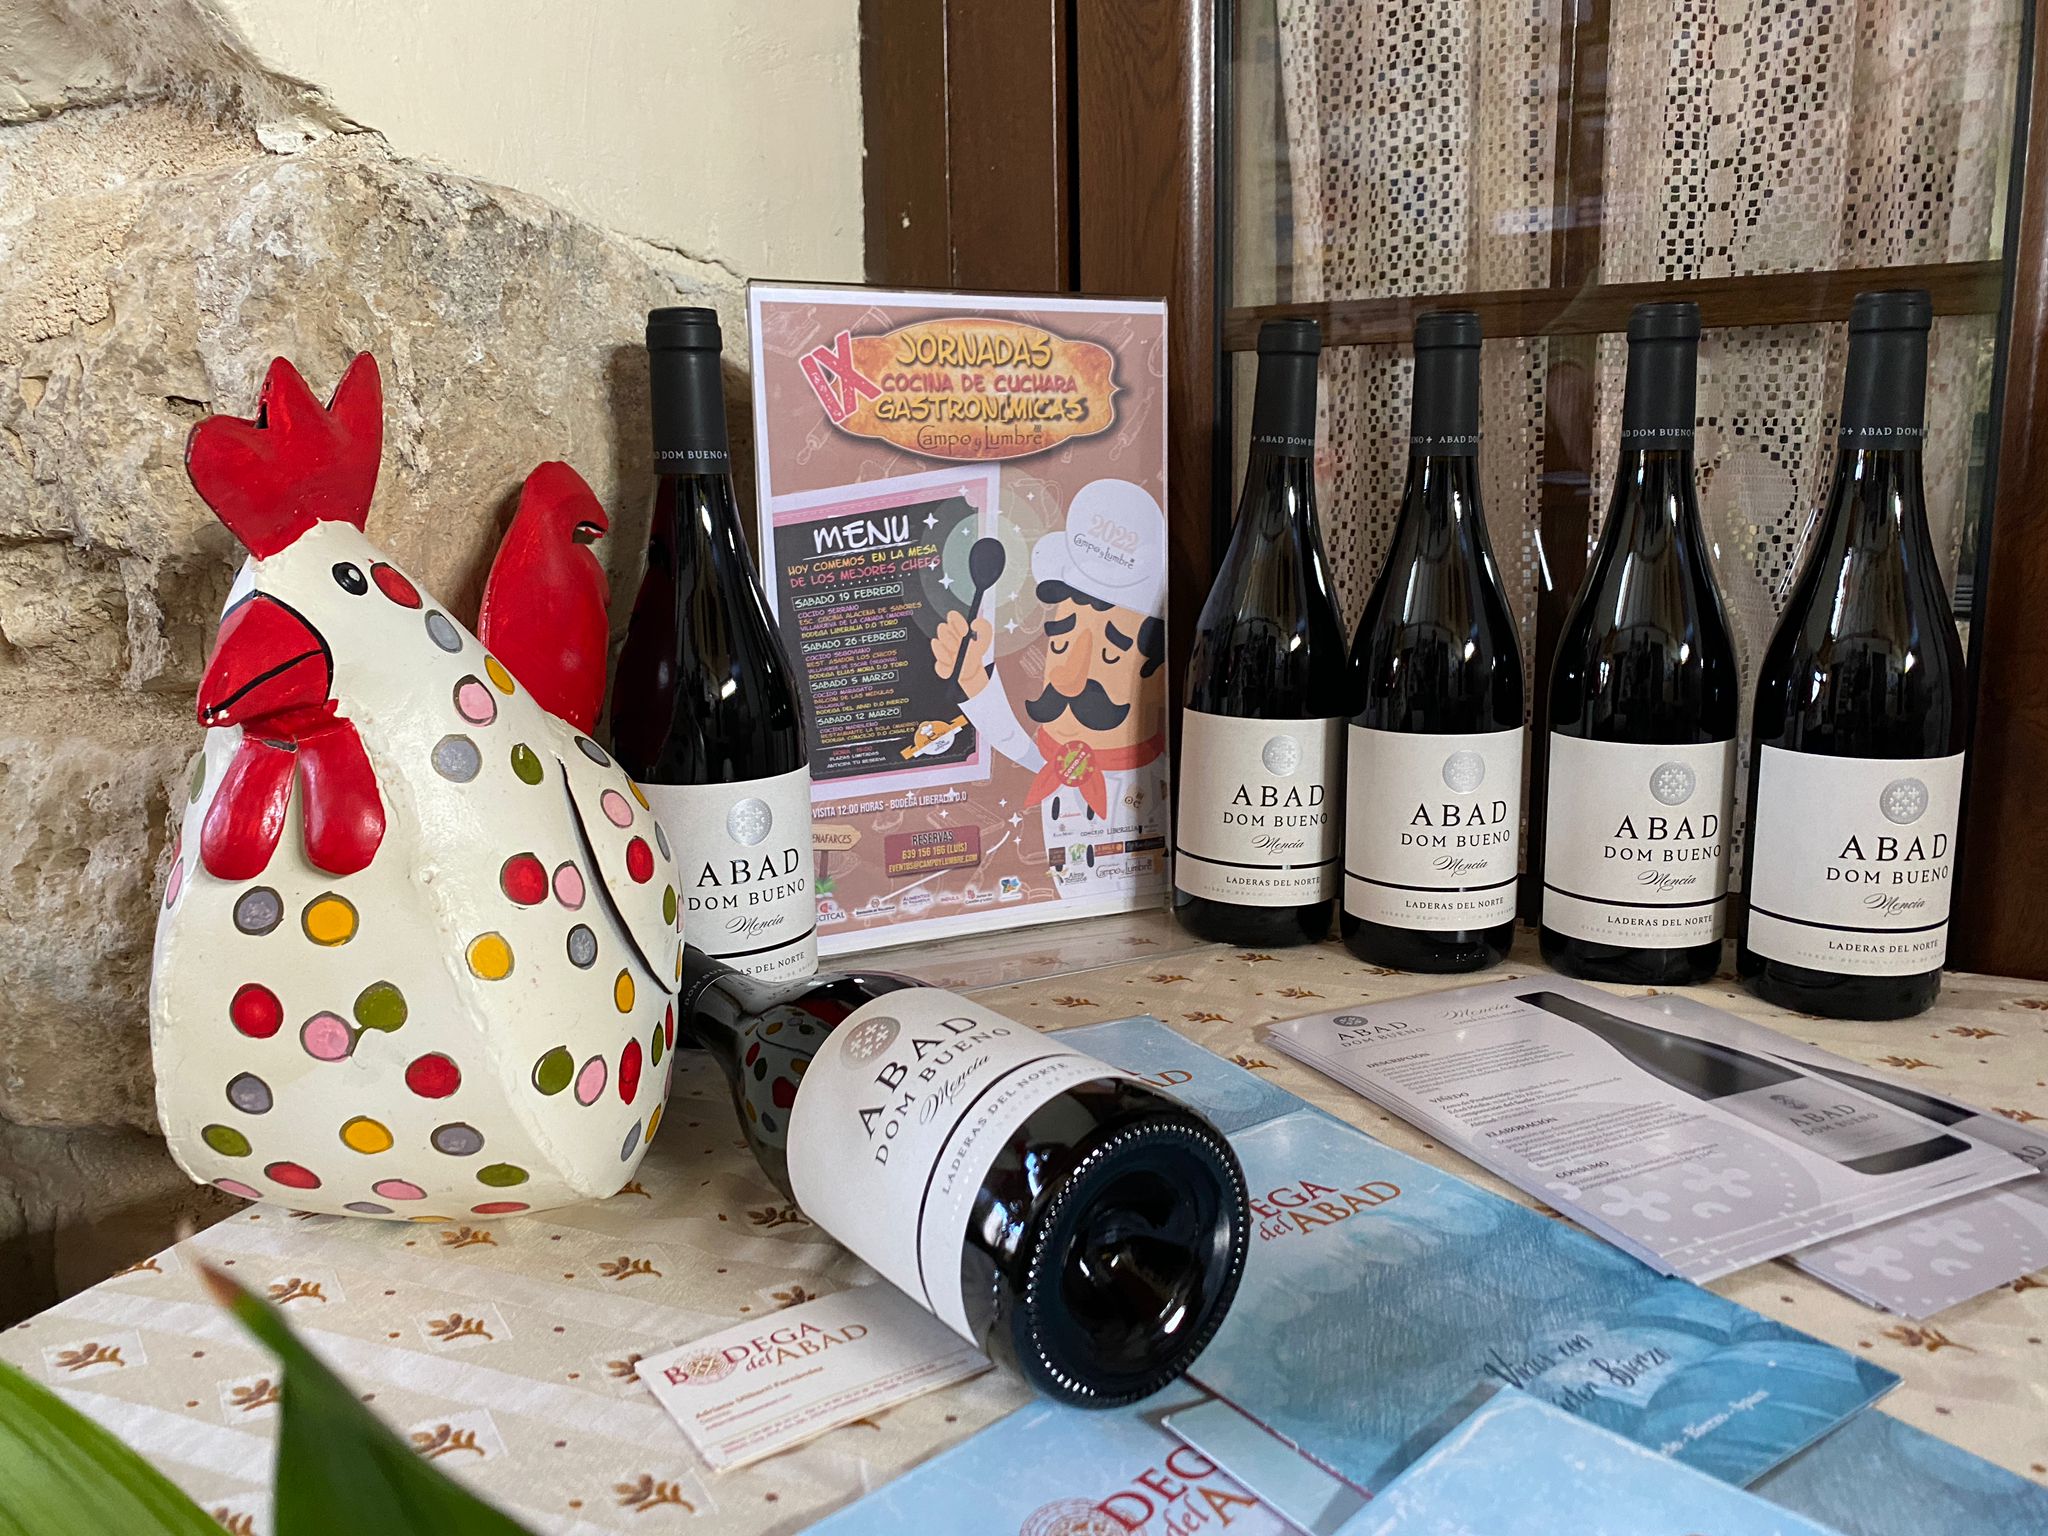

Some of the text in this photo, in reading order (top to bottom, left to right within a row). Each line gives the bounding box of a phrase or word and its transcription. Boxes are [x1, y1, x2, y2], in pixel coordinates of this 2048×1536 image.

[896, 333, 1053, 368] JORNADAS
[799, 330, 882, 424] IX
[881, 373, 1078, 393] COCINA DE CUCHARA
[917, 424, 1042, 454] Campo y Lumbre
[1260, 435, 1307, 446] ABAD DOM
[1439, 436, 1466, 444] ABAD
[1633, 429, 1656, 437] DOM
[1660, 429, 1691, 437] BUENO
[1860, 427, 1918, 436] ABAD DOM
[661, 450, 722, 459] DOM BUENO
[813, 515, 909, 554] MENU
[1088, 514, 1138, 554] 2022
[788, 544, 938, 575] HOY COMEMOS EN LA MESA
[1074, 533, 1101, 553] Campo
[1104, 546, 1135, 570] Lumbre
[790, 555, 941, 588] DE LOS MEJORES CHEFS
[795, 584, 901, 608] SABADO 19 FEBRERO
[802, 630, 906, 653] SABADO 26 FEBRERO
[811, 672, 895, 690] SABADO 5 MARZO
[816, 715, 852, 726] SABADO
[868, 708, 900, 718] MARZO
[1232, 784, 1325, 807] ABAD
[812, 807, 835, 818] VISITA
[838, 804, 859, 815] 12:00
[860, 801, 884, 812] HORAS
[891, 797, 917, 808] BODEGA
[1410, 800, 1507, 827] ABAD
[1223, 812, 1328, 827] DOM BUENO
[1614, 814, 1718, 840] ABAD
[813, 833, 852, 844] ENAFARCES
[912, 831, 953, 845] RESERVAS
[1401, 830, 1510, 848] DOM BUENO
[1838, 833, 1948, 862] ABAD
[1604, 845, 1721, 862] DOM BUENO
[696, 848, 800, 888] ABAD
[1826, 865, 1949, 885] DOM BUENO
[1226, 876, 1321, 887] LADERAS DEL NORTE
[688, 878, 805, 911] DOM BUENO
[1405, 897, 1504, 910] LADERAS DEL NORTE
[1607, 915, 1713, 927] LADERAS DEL NORTE
[1828, 939, 1939, 953] LADERAS DEL NORTE
[755, 963, 775, 974] DEL
[778, 951, 805, 968] NORTE
[1337, 1021, 1409, 1042] ABAD
[1340, 1026, 1427, 1048] DOM BUENO
[858, 1016, 978, 1140] ABAD
[875, 1027, 1013, 1167] DOM BUENO
[1789, 1104, 1856, 1127] ABAD
[942, 1117, 989, 1195] LADERAS
[987, 1089, 1016, 1115] DEL
[1017, 1062, 1070, 1089] NORTE
[1259, 1181, 1402, 1242] del ABAD
[746, 1323, 869, 1373] del ABAD
